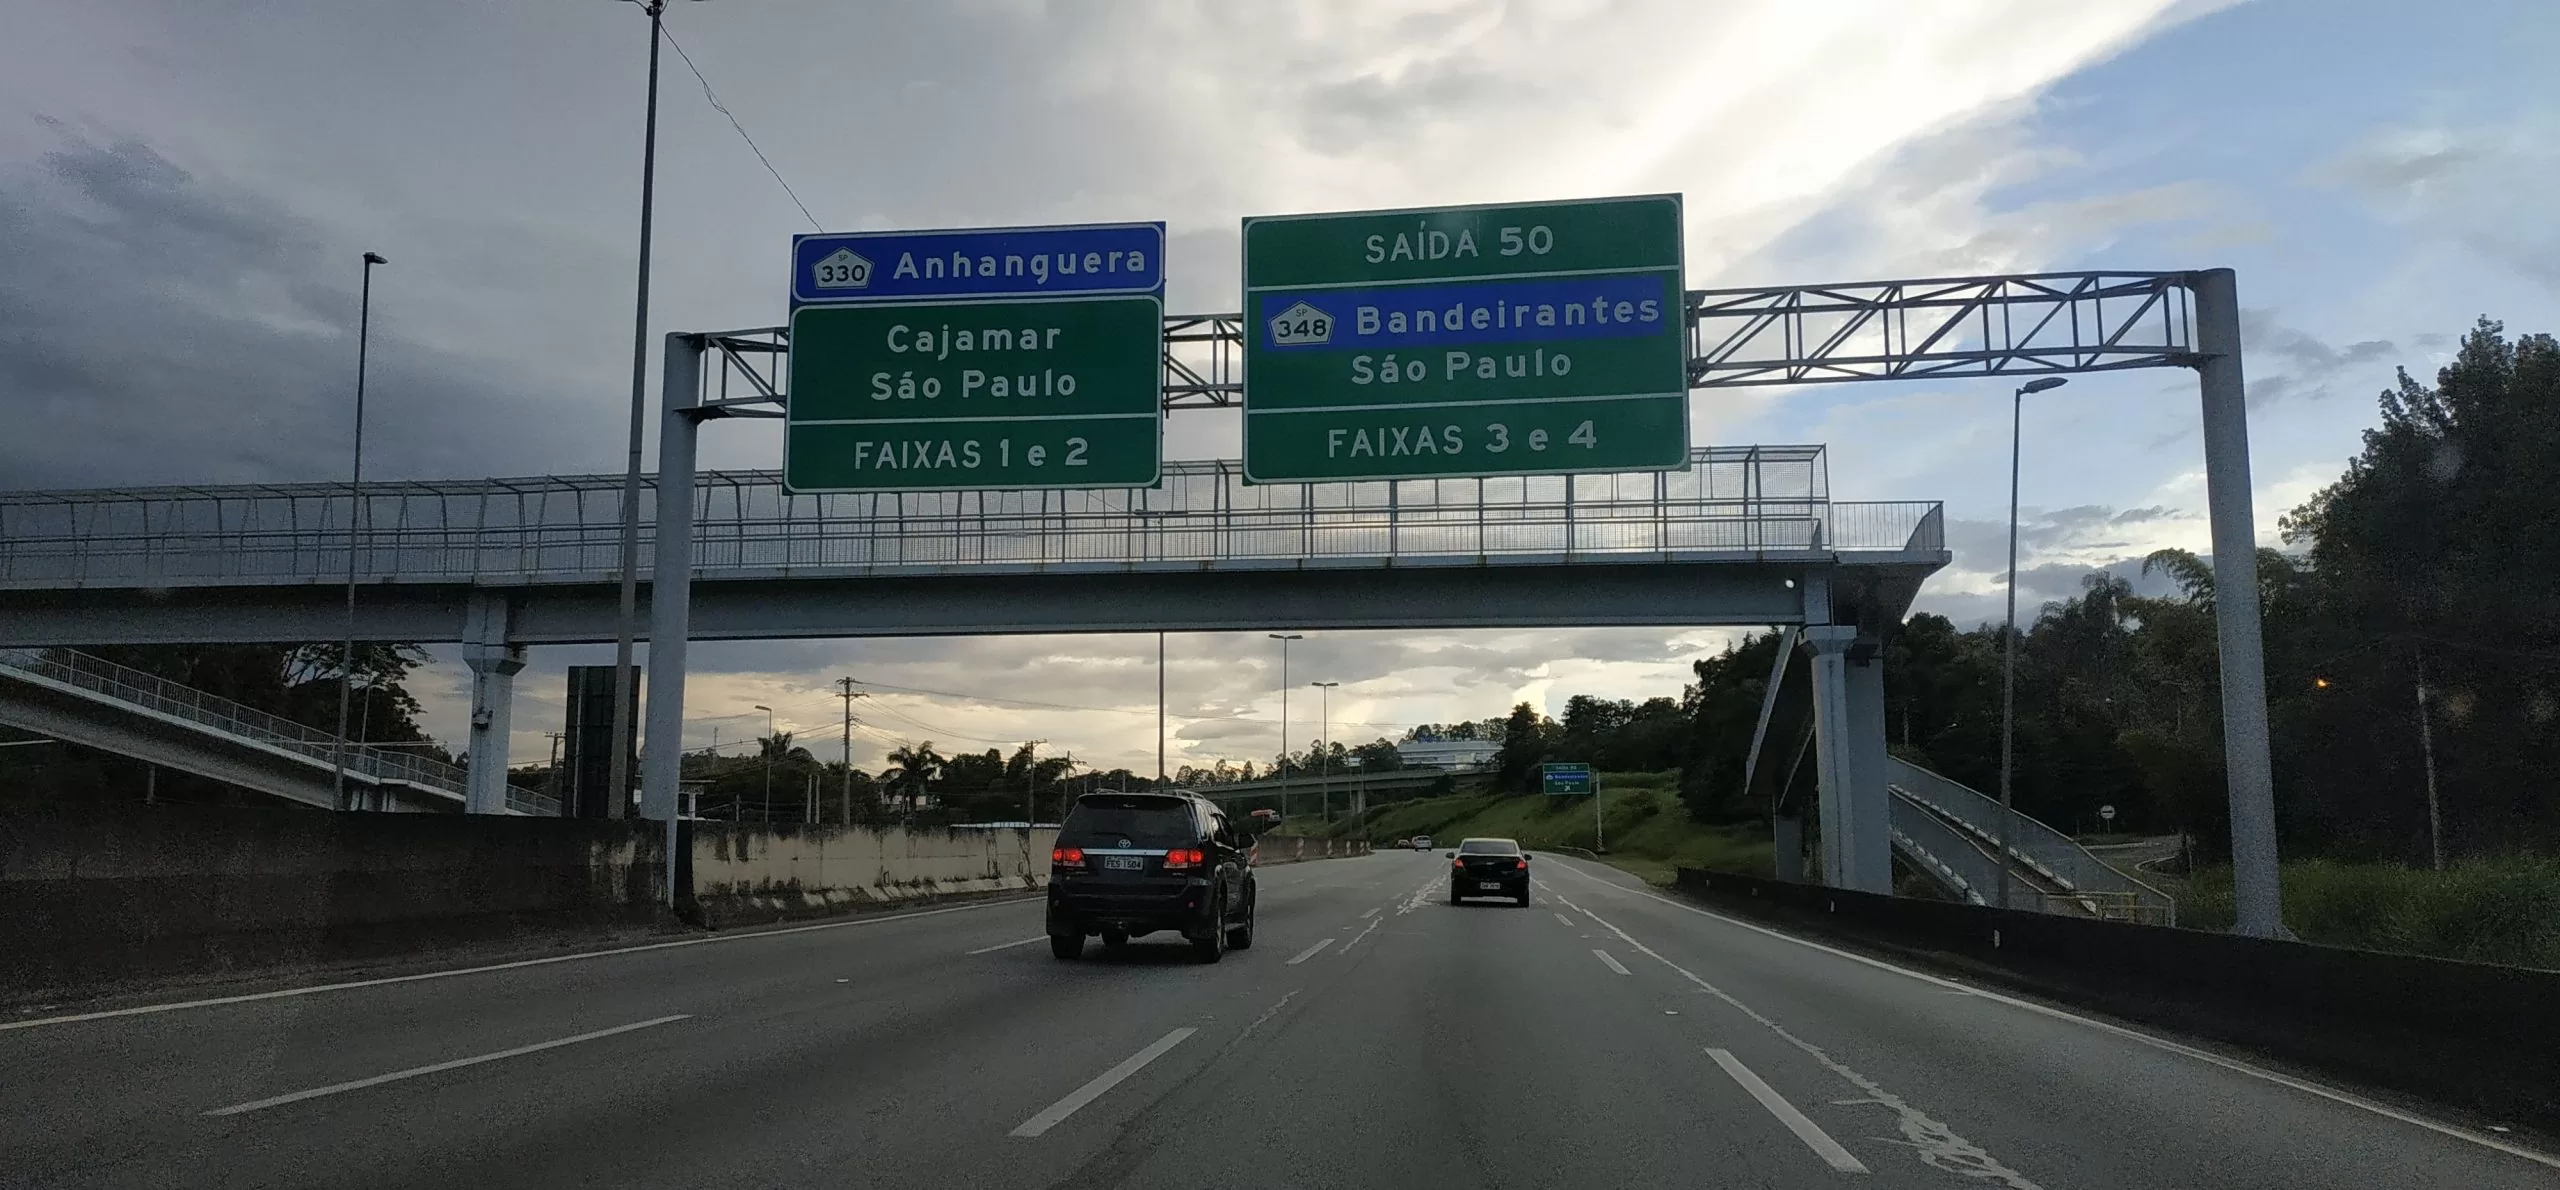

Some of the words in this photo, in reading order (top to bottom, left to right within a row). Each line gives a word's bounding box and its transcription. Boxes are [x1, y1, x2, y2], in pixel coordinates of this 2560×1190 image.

[837, 254, 849, 262] SP
[1365, 220, 1479, 263] SAÍDA
[1500, 225, 1554, 256] 50
[821, 264, 866, 283] 330
[893, 250, 1146, 285] Anhanguera
[1278, 318, 1327, 338] 348
[1295, 308, 1308, 318] SP
[1356, 295, 1660, 335] Bandeirantes
[887, 324, 1061, 361] Cajamar
[1446, 348, 1571, 381] Paulo
[962, 368, 1076, 398] Paulo
[855, 440, 981, 470] FAIXAS
[999, 438, 1009, 467] 1
[1027, 445, 1046, 467] e
[1064, 437, 1088, 466] 2
[1328, 425, 1464, 458] FAIXAS
[1485, 423, 1510, 453] 3
[1528, 428, 1549, 451] e
[1568, 420, 1597, 449] 4
